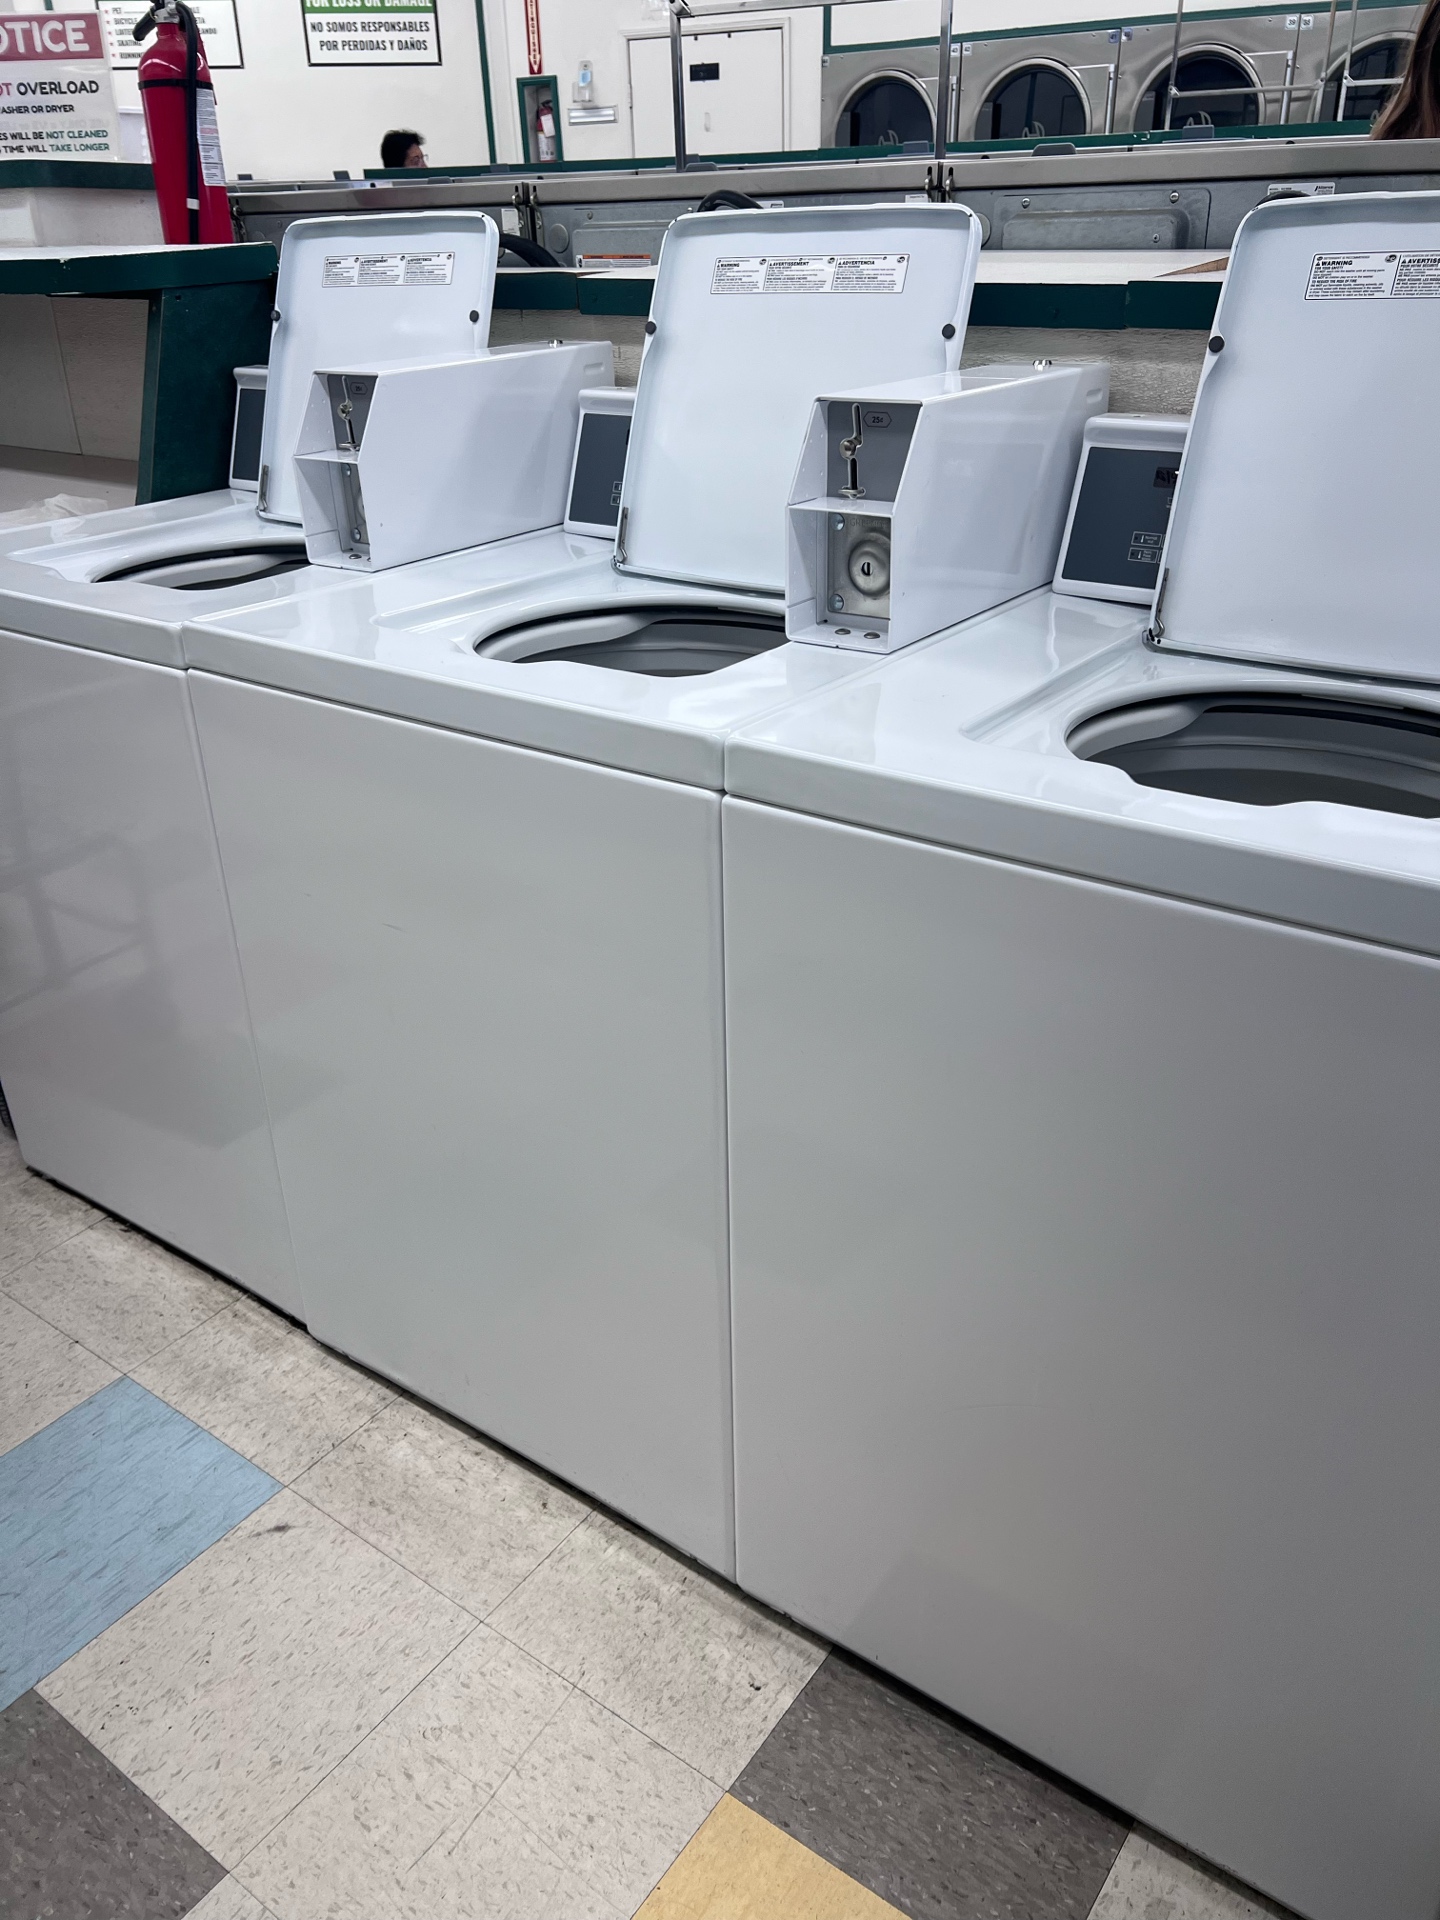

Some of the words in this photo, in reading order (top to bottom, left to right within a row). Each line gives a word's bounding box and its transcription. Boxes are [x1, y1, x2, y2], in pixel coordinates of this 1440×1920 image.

[310, 21, 323, 32] NO
[326, 21, 358, 32] SOMOS
[360, 21, 430, 32] RESPONSABLES
[319, 40, 339, 51] POR
[341, 40, 387, 51] PERDIDAS
[388, 40, 394, 51] Y
[397, 36, 428, 51] DAÑOS
[16, 80, 99, 96] OVERLOAD
[0, 105, 30, 115] ASHER
[31, 105, 44, 114] OR
[46, 104, 75, 113] DRYER
[9, 131, 31, 140] WILL
[32, 131, 44, 140] BE
[46, 130, 64, 139] NOT
[67, 129, 108, 139] CLEANED
[2, 145, 25, 154] TIME
[26, 144, 48, 153] WILL
[49, 143, 73, 153] TAKE
[74, 142, 110, 152] LONGER
